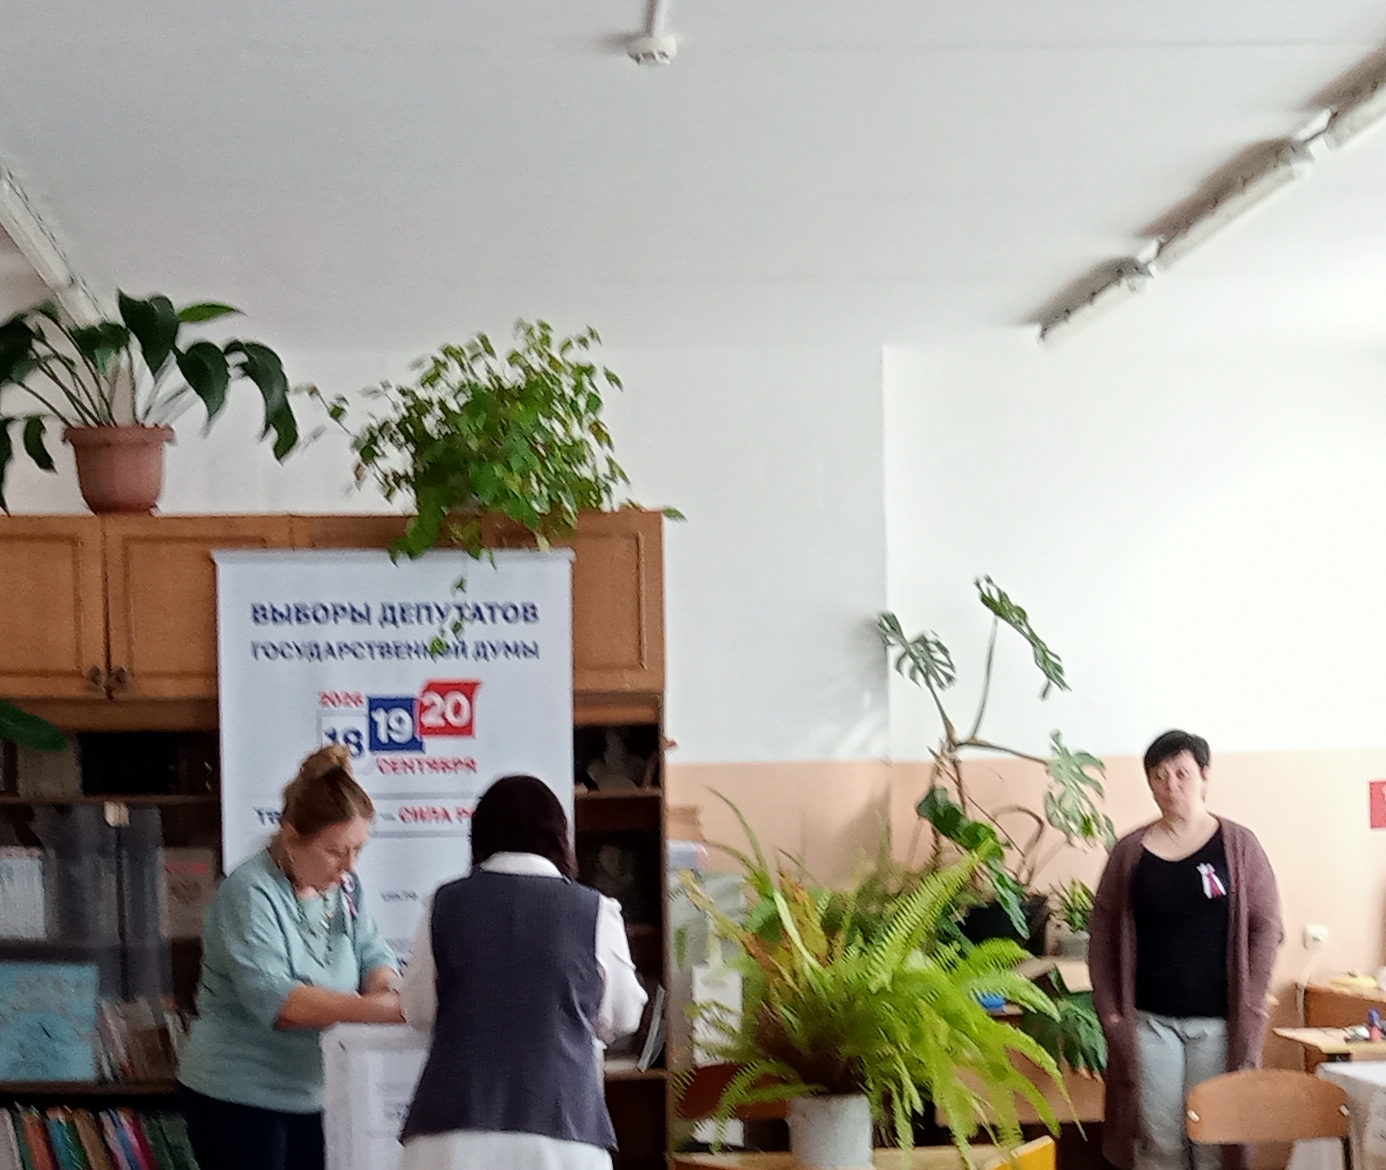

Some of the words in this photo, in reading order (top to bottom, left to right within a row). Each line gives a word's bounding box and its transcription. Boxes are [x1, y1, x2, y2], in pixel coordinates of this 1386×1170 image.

[251, 602, 371, 625] ВЫБОРЫ
[379, 602, 540, 628] ДЕПУТАТОВ
[473, 640, 540, 662] ДУМЫ
[420, 690, 470, 727] 20
[371, 707, 413, 744] 19
[377, 758, 477, 774] СЕНТЯБРЯ
[399, 807, 452, 823] СИЛА
